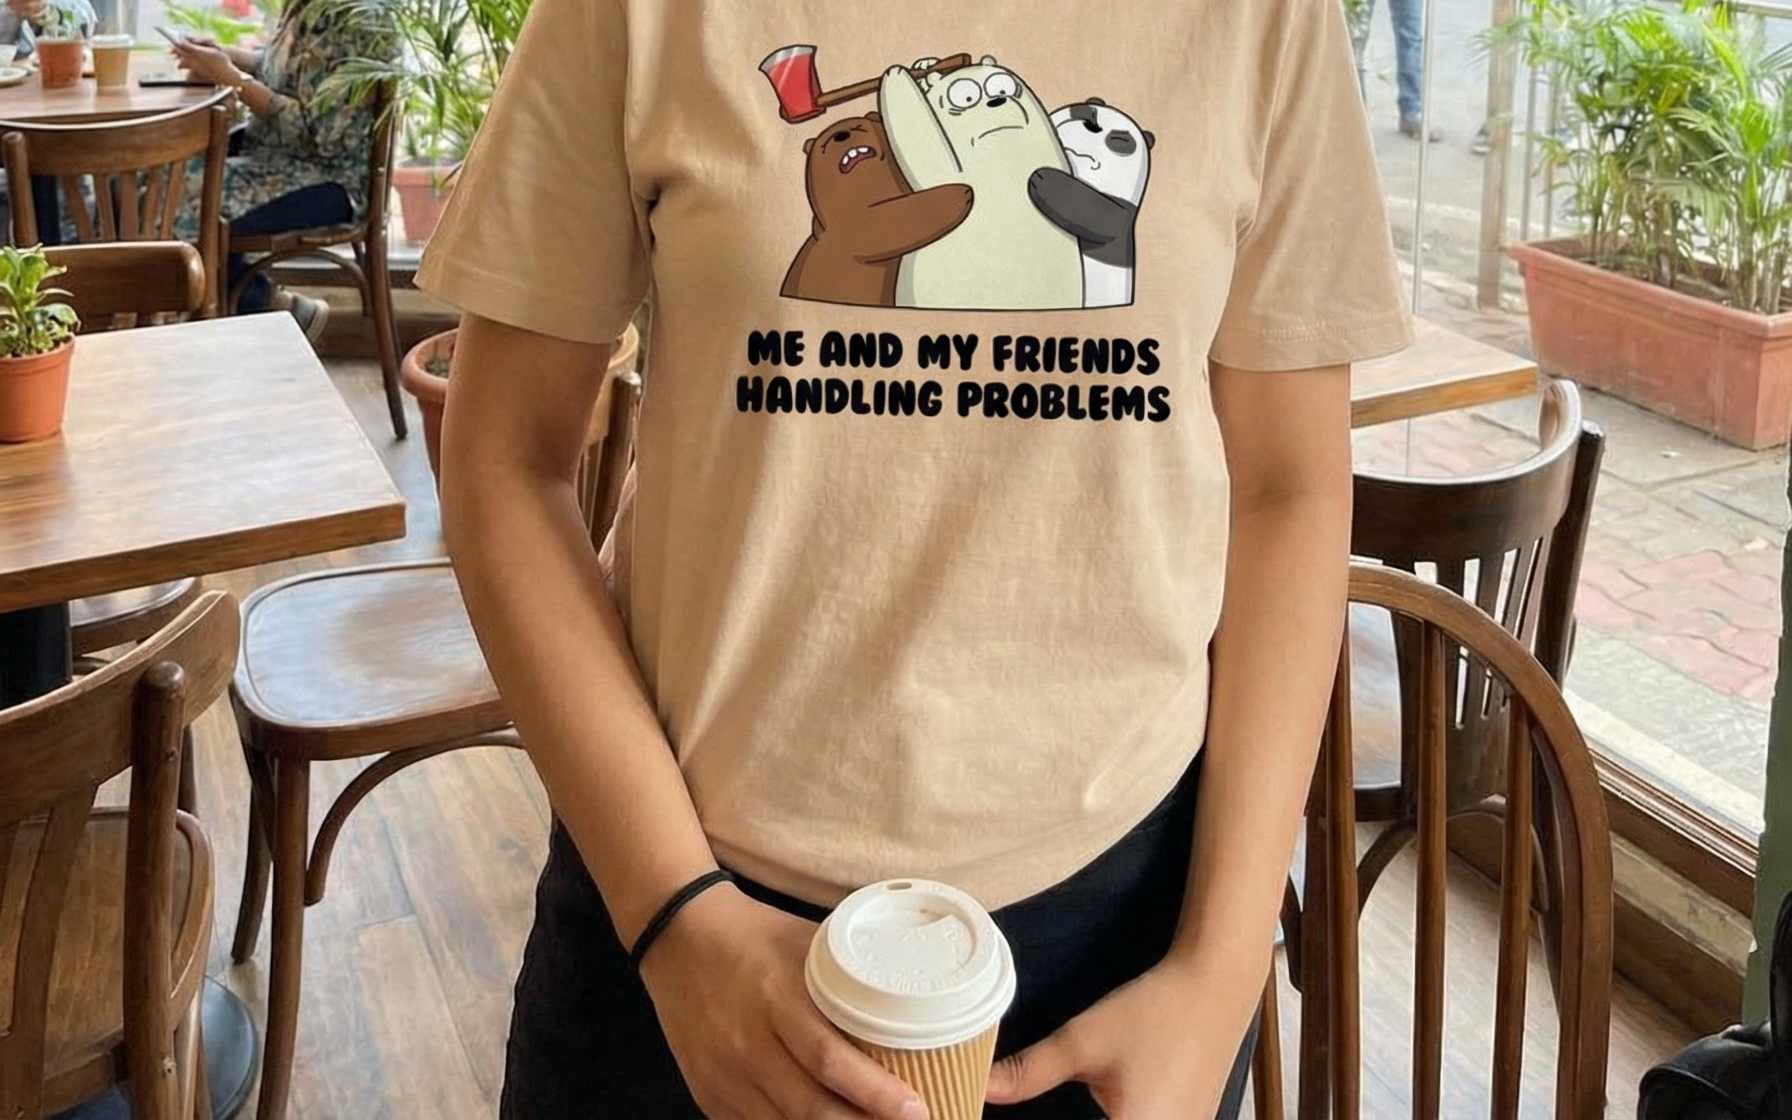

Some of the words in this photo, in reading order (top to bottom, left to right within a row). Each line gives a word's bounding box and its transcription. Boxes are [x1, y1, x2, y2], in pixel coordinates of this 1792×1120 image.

[748, 330, 804, 367] ME
[819, 331, 904, 369] AND
[917, 334, 979, 371] MY
[992, 335, 1161, 376] FRIENDS
[735, 375, 943, 417] HANDLING
[957, 382, 1171, 423] PROBLEMS
